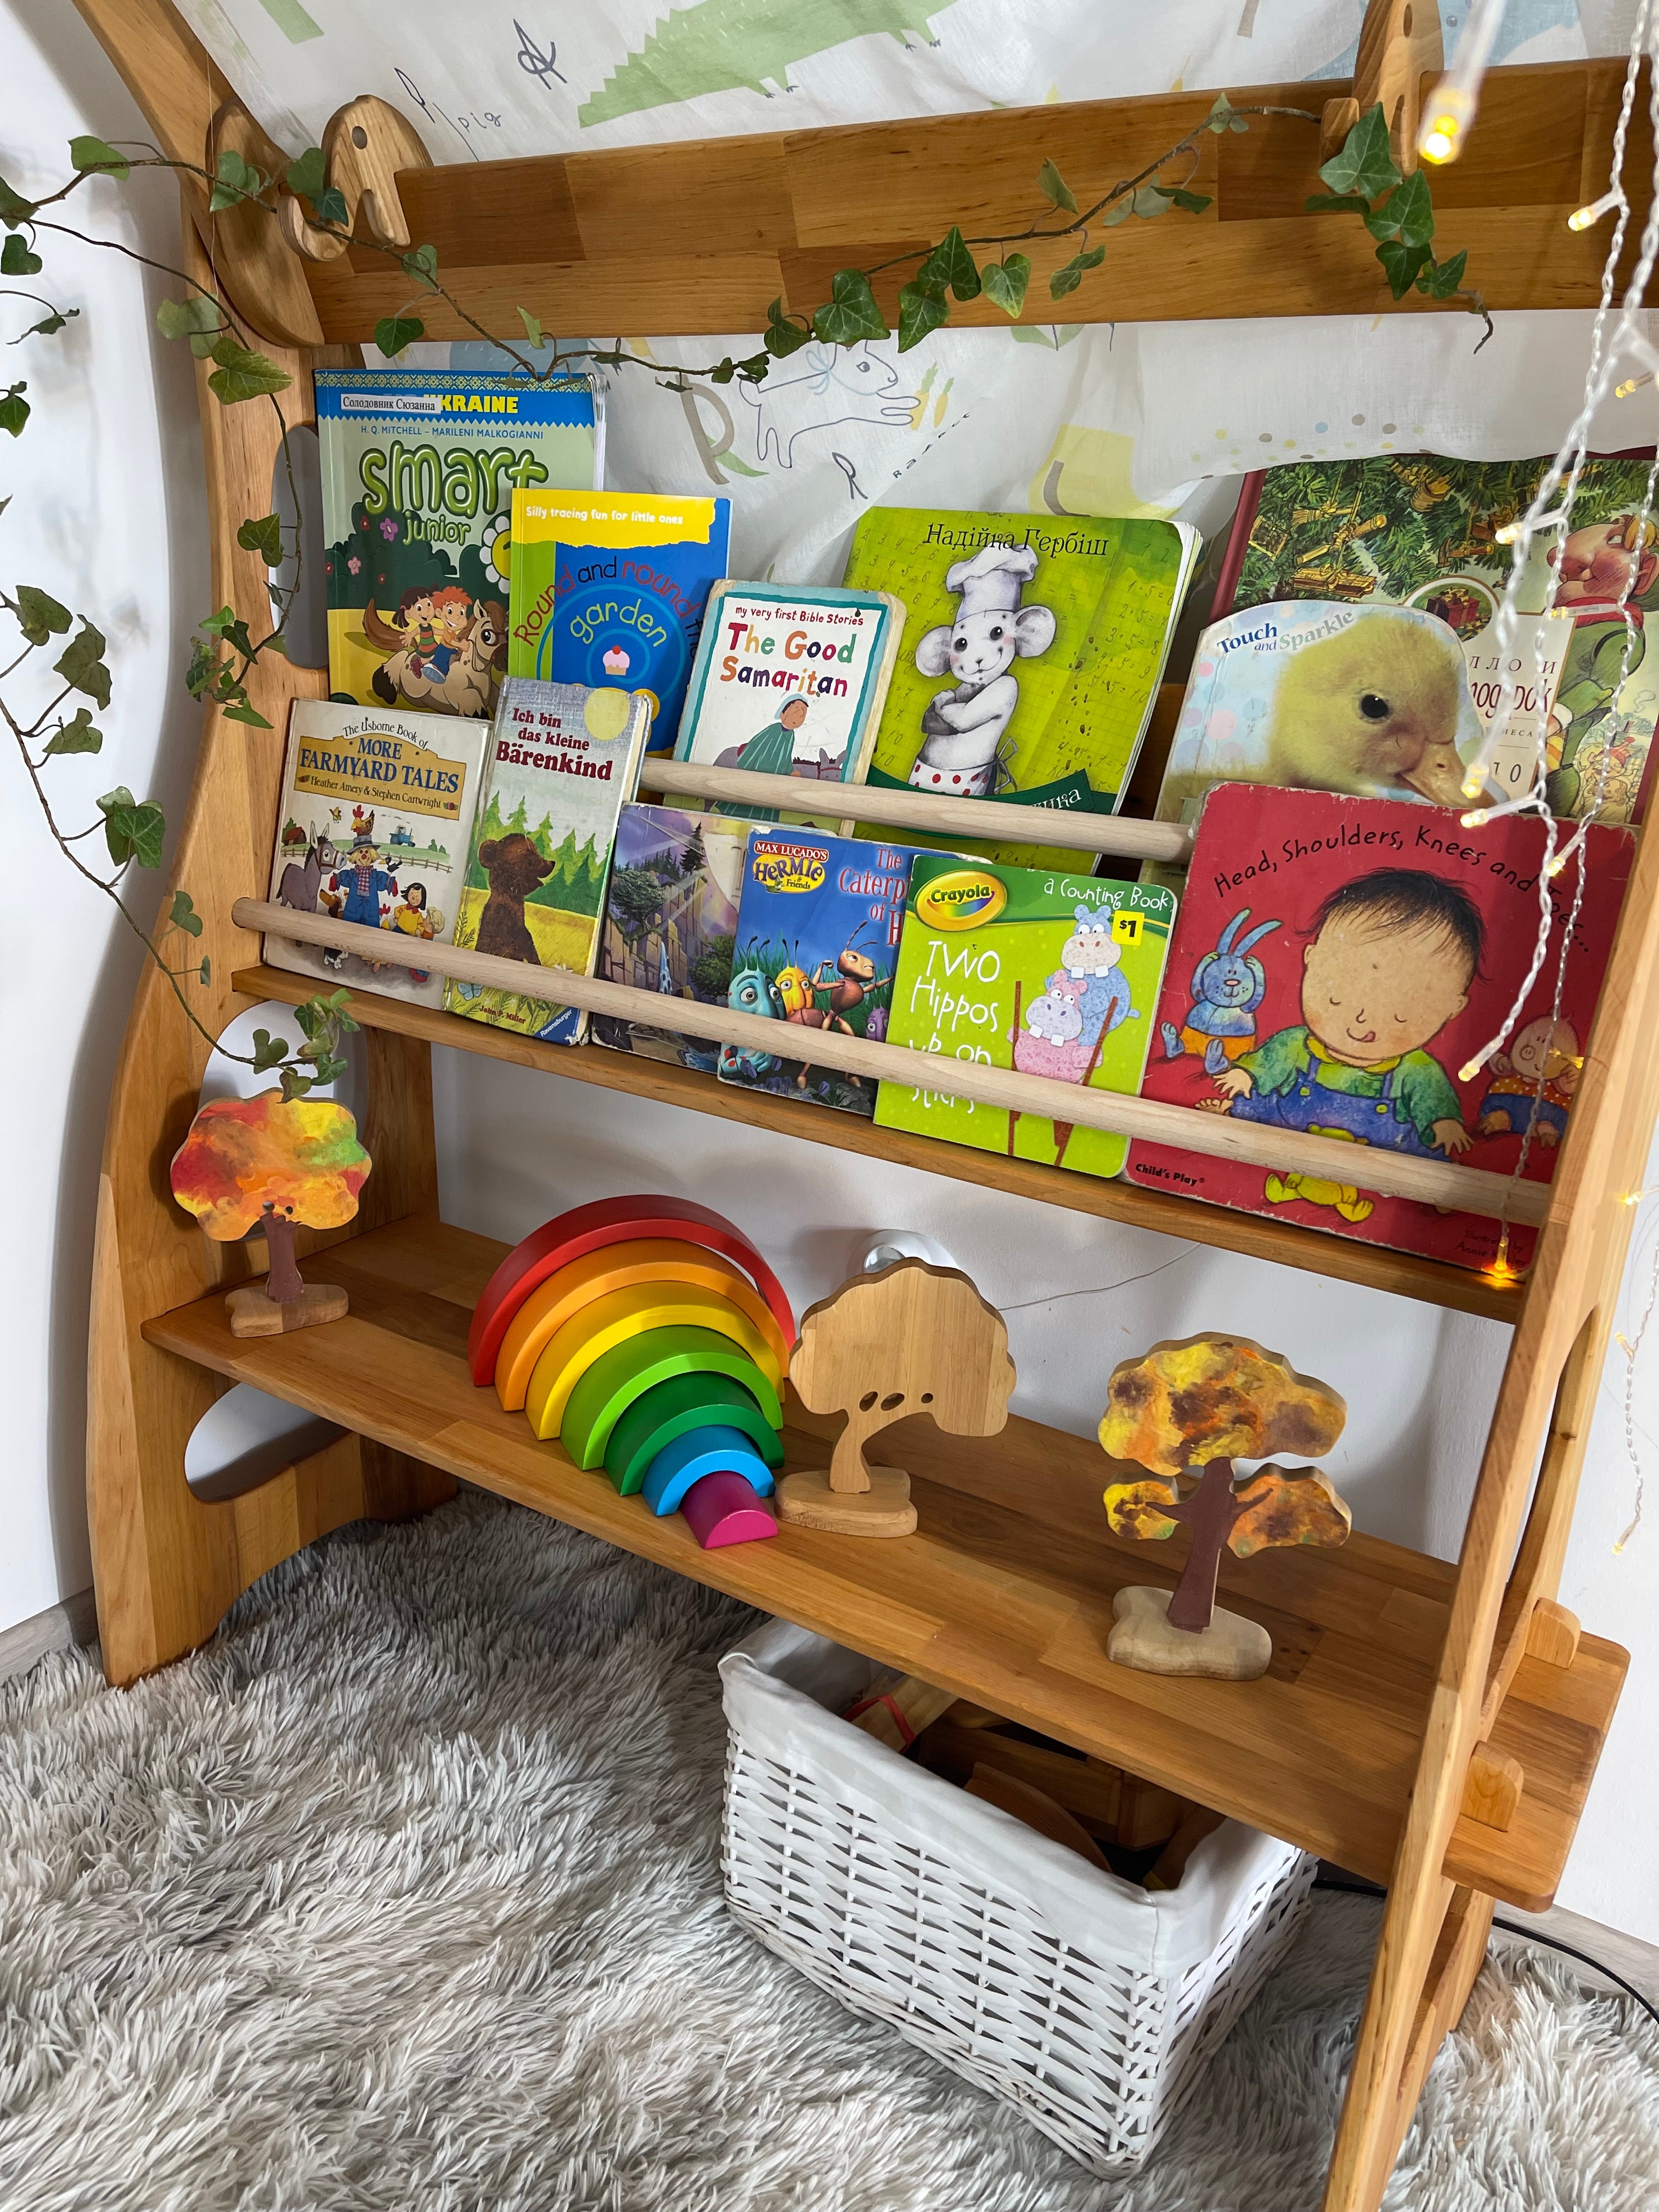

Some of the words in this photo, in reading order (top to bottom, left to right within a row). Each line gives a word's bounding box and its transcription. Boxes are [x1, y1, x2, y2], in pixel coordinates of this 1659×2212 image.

[343, 396, 394, 410] Солодовник
[396, 398, 436, 411] Сюзанна
[424, 393, 519, 414] KRAINE
[360, 425, 369, 434] H.
[371, 425, 380, 435] Q.
[381, 425, 422, 436] MITCHELL
[432, 427, 473, 438] MARILENI
[476, 429, 544, 440] MALKOGIANNI
[359, 439, 549, 520] smart
[403, 509, 471, 546] junior
[526, 506, 548, 519] Silly
[550, 507, 588, 521] tracing
[591, 509, 607, 521] fun
[611, 510, 628, 521] for
[631, 510, 655, 523] little
[658, 515, 684, 525] ones
[922, 522, 1015, 551] Надійка
[1022, 527, 1110, 559] Гербіш
[513, 563, 577, 647] Round
[577, 556, 617, 584] and
[621, 560, 702, 619] round
[735, 606, 747, 618] my
[751, 607, 771, 620] very
[774, 607, 798, 620] first
[799, 611, 824, 623] Bible
[826, 613, 864, 626] Stories
[570, 598, 668, 648] garden
[1217, 622, 1278, 654] Touch
[1254, 639, 1277, 651] and
[1279, 611, 1356, 651] Sparkle
[727, 622, 775, 655] The
[784, 630, 857, 664] Good
[719, 655, 848, 697] Samaritan
[342, 723, 359, 740] The
[361, 716, 395, 733] Usborne
[397, 723, 419, 743] Book
[419, 738, 429, 750] of
[512, 707, 535, 724] Ich
[539, 712, 562, 729] bin
[357, 737, 403, 760] MORE
[517, 728, 541, 744] das
[545, 730, 590, 752] kleine
[300, 748, 398, 782] FARMYARD
[401, 764, 460, 794] TALES
[495, 740, 613, 781] Bärenkind
[311, 776, 340, 791] Heather
[339, 781, 364, 796] Amery
[363, 786, 371, 795] &
[371, 787, 401, 802] Stephen
[402, 792, 442, 809] Cartwright
[757, 842, 778, 854] MAX
[781, 845, 828, 861] LUCADO'S
[877, 848, 903, 870] The
[1214, 850, 1277, 898] Head,
[1282, 823, 1404, 862] Shoulders,
[1415, 825, 1487, 866] Knees
[1489, 862, 1540, 892] and
[786, 878, 811, 889] Friends
[930, 885, 991, 902] Crayola
[1043, 878, 1056, 895] a
[1060, 878, 1125, 910] Counting
[1130, 885, 1169, 911] Book
[870, 902, 887, 922] of
[1119, 919, 1137, 938] $1
[926, 940, 1001, 983] TWO
[479, 1005, 496, 1015] John
[506, 1012, 526, 1024] Miller
[910, 975, 998, 1032] Hippos
[540, 1008, 573, 1037] Ravensburger
[1135, 1163, 1171, 1179] Child's
